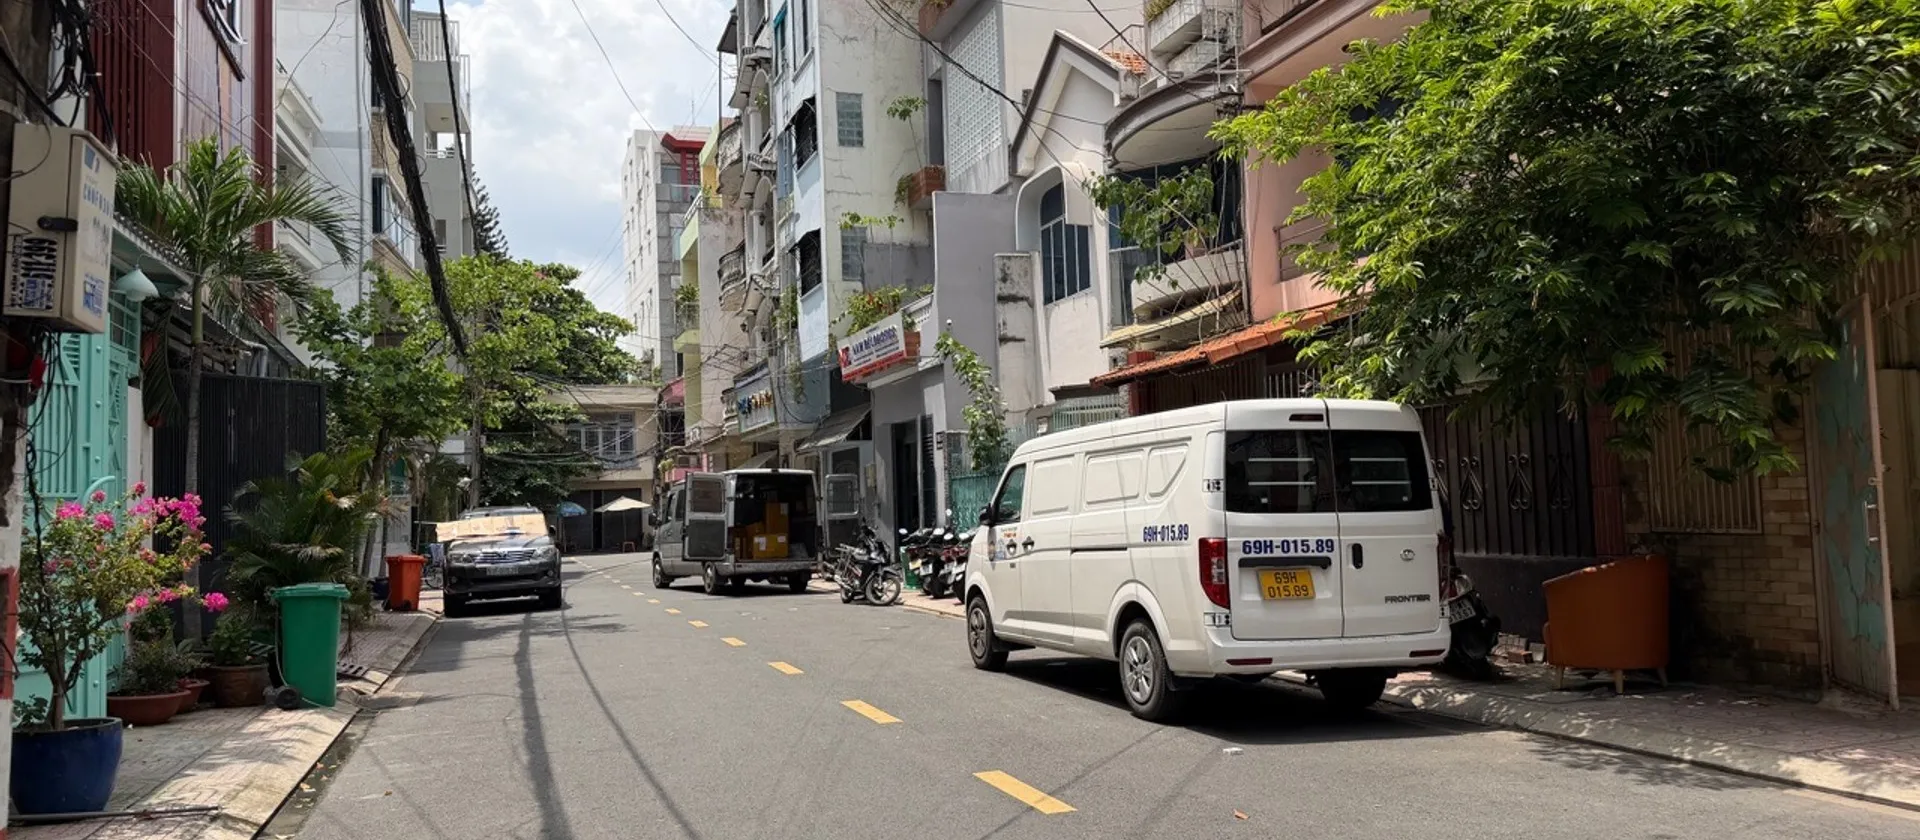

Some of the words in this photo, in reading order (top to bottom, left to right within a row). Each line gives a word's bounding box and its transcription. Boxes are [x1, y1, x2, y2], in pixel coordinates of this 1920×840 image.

[1143, 523, 1189, 542] 69H-015.89
[1242, 538, 1335, 555] 69H-015.89
[1273, 571, 1298, 584] 69H
[1267, 585, 1309, 598] 015.89
[1385, 594, 1431, 604] FRONTIER
